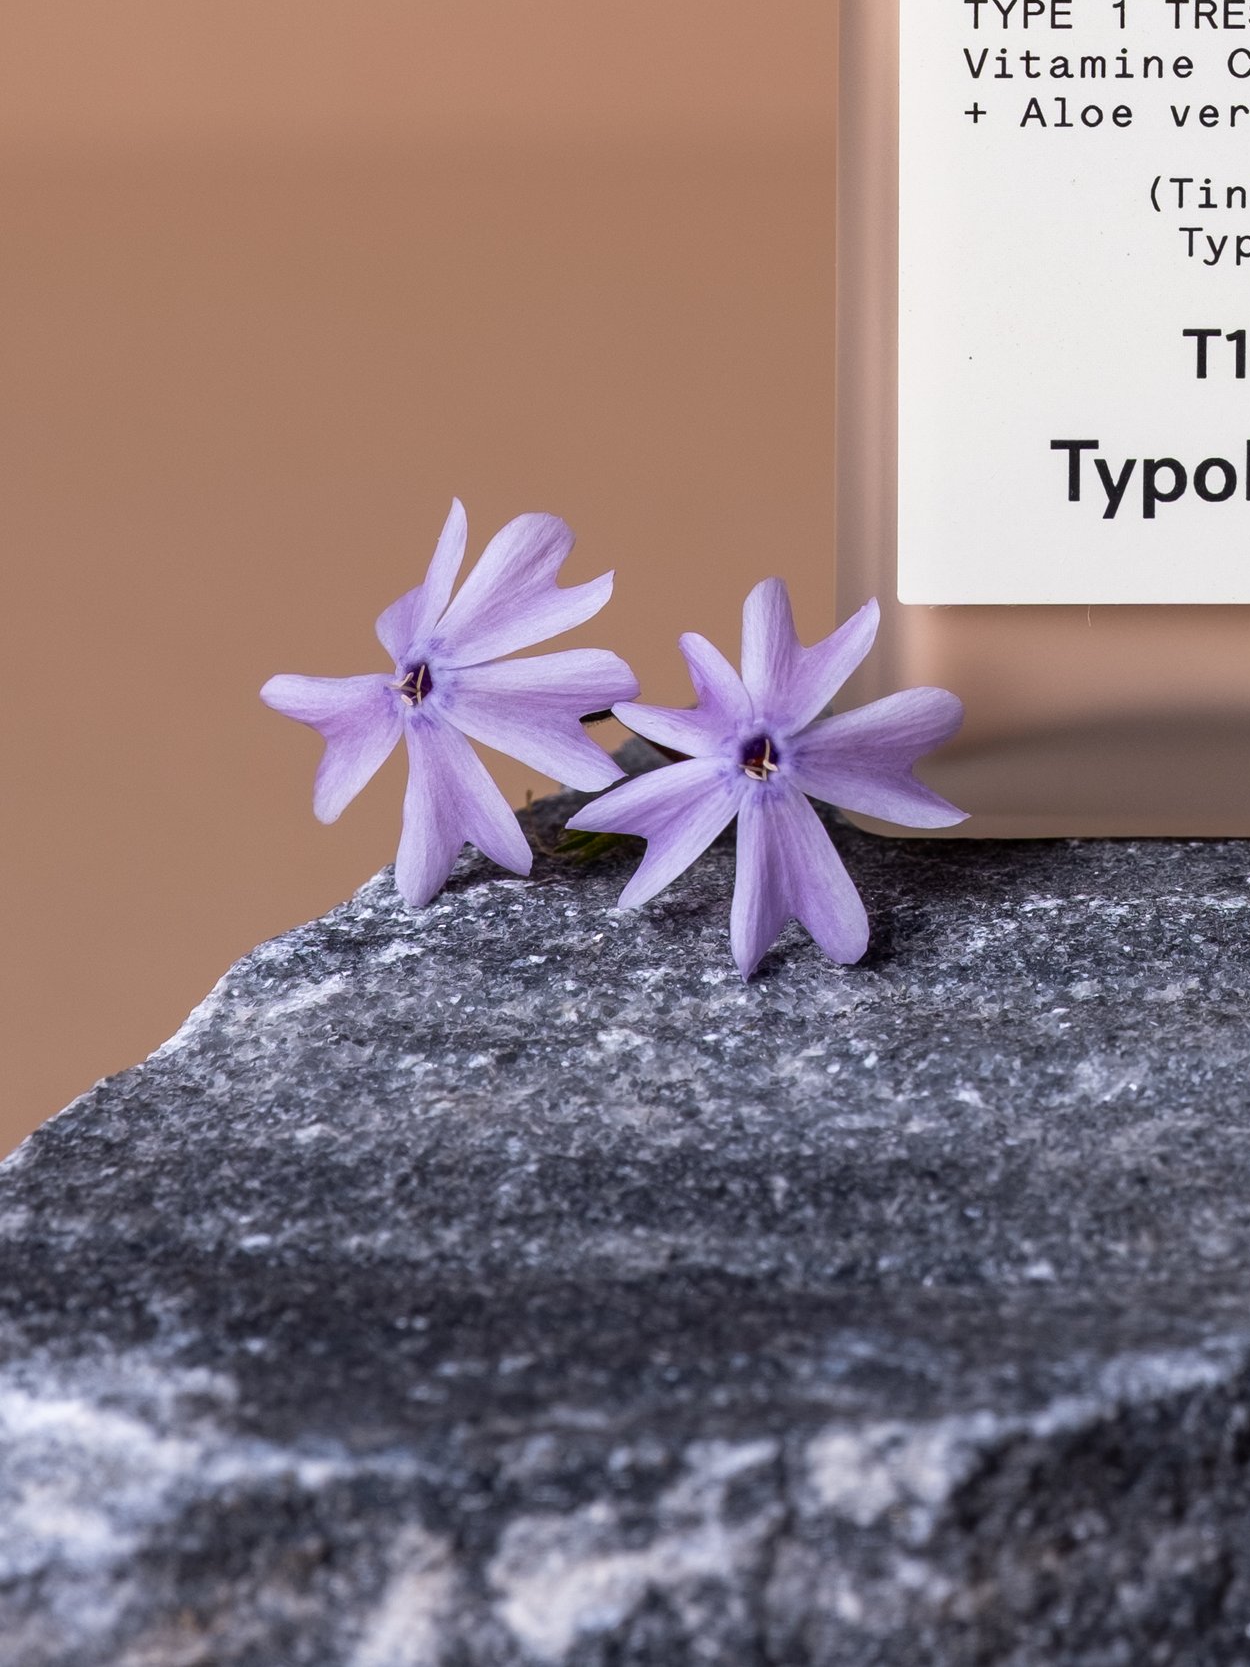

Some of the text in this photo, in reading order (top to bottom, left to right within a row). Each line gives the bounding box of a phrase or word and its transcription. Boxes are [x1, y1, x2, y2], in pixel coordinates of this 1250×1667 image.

[962, 47, 1194, 79] Vitamine
[964, 101, 987, 124] +
[1019, 96, 1133, 128] Aloe
